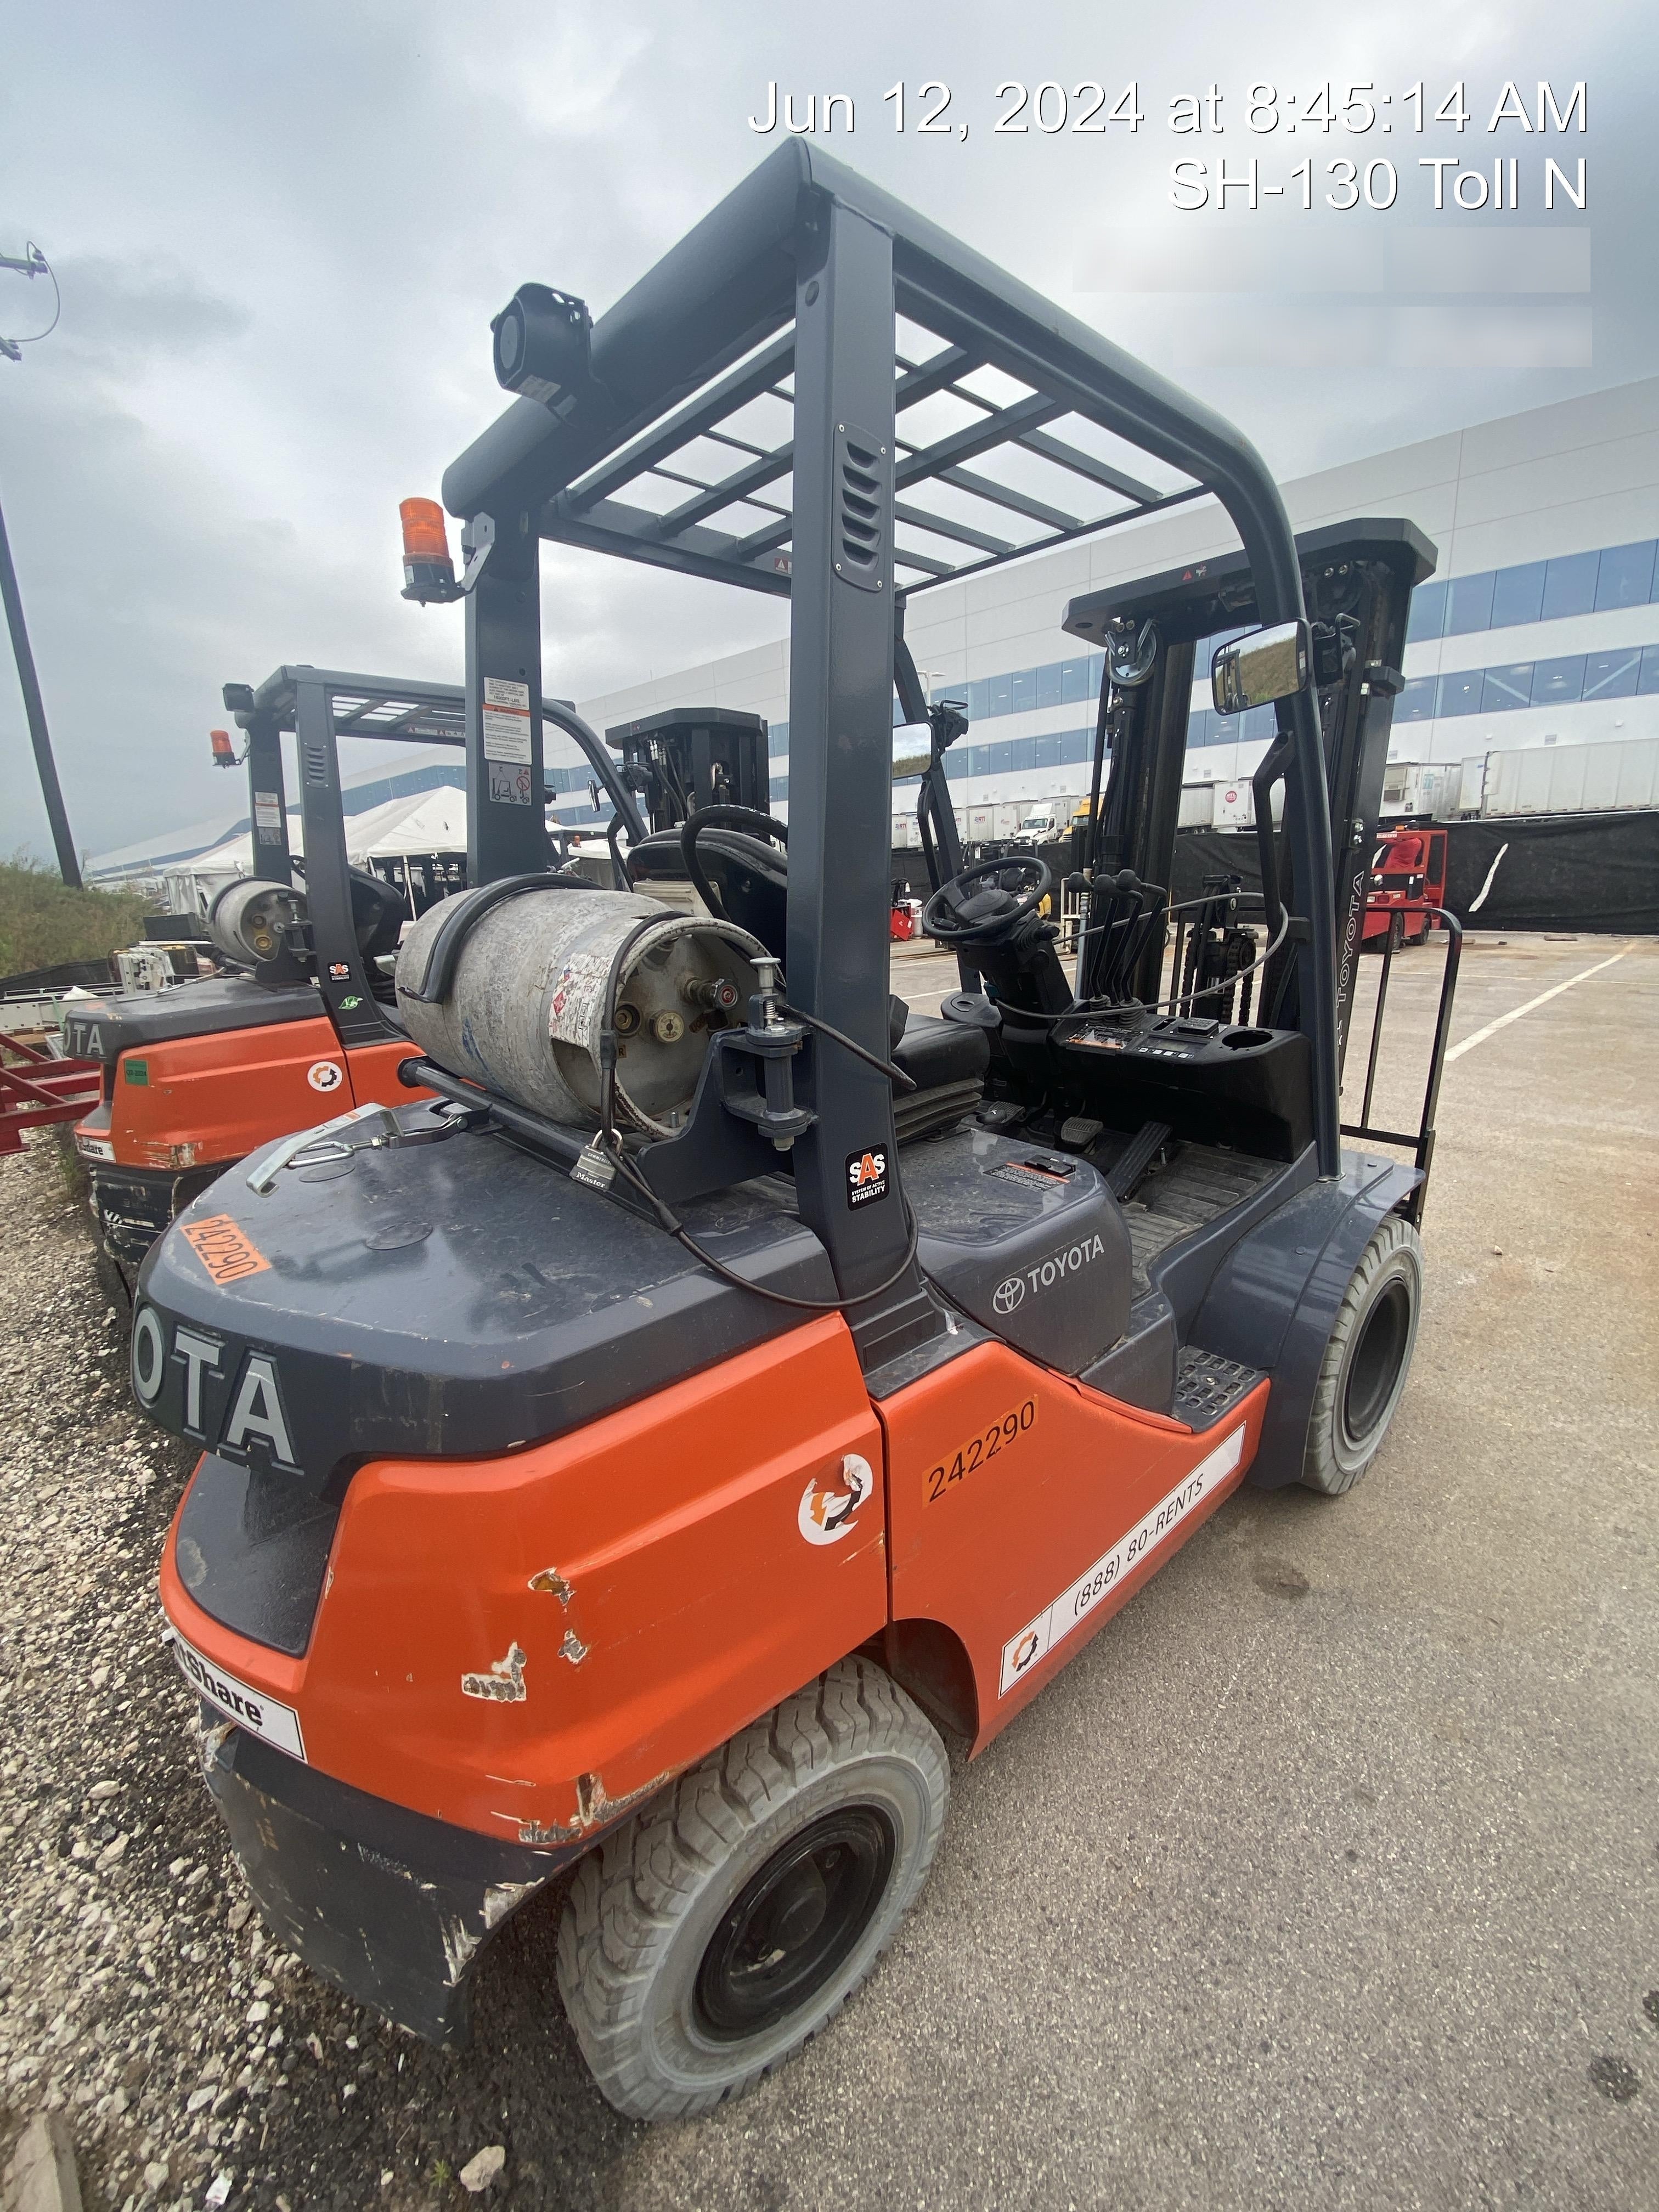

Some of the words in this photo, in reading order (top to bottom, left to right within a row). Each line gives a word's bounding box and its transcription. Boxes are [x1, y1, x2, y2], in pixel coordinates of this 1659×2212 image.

[1336, 871, 1364, 1009] TOYOTA
[329, 963, 349, 975] SAS
[576, 1172, 606, 1188] Master
[849, 1153, 885, 1186] SAS
[851, 1187, 866, 1196] SYSTEM
[872, 1180, 885, 1188] ACTIVE
[852, 1184, 885, 1203] STABILITY
[184, 1220, 258, 1279] 242290
[1027, 1234, 1105, 1293] TOYOTA
[928, 1401, 1035, 1503] 242290
[1074, 1555, 1121, 1616] (888)
[1127, 1473, 1204, 1562] 80-RENTS
